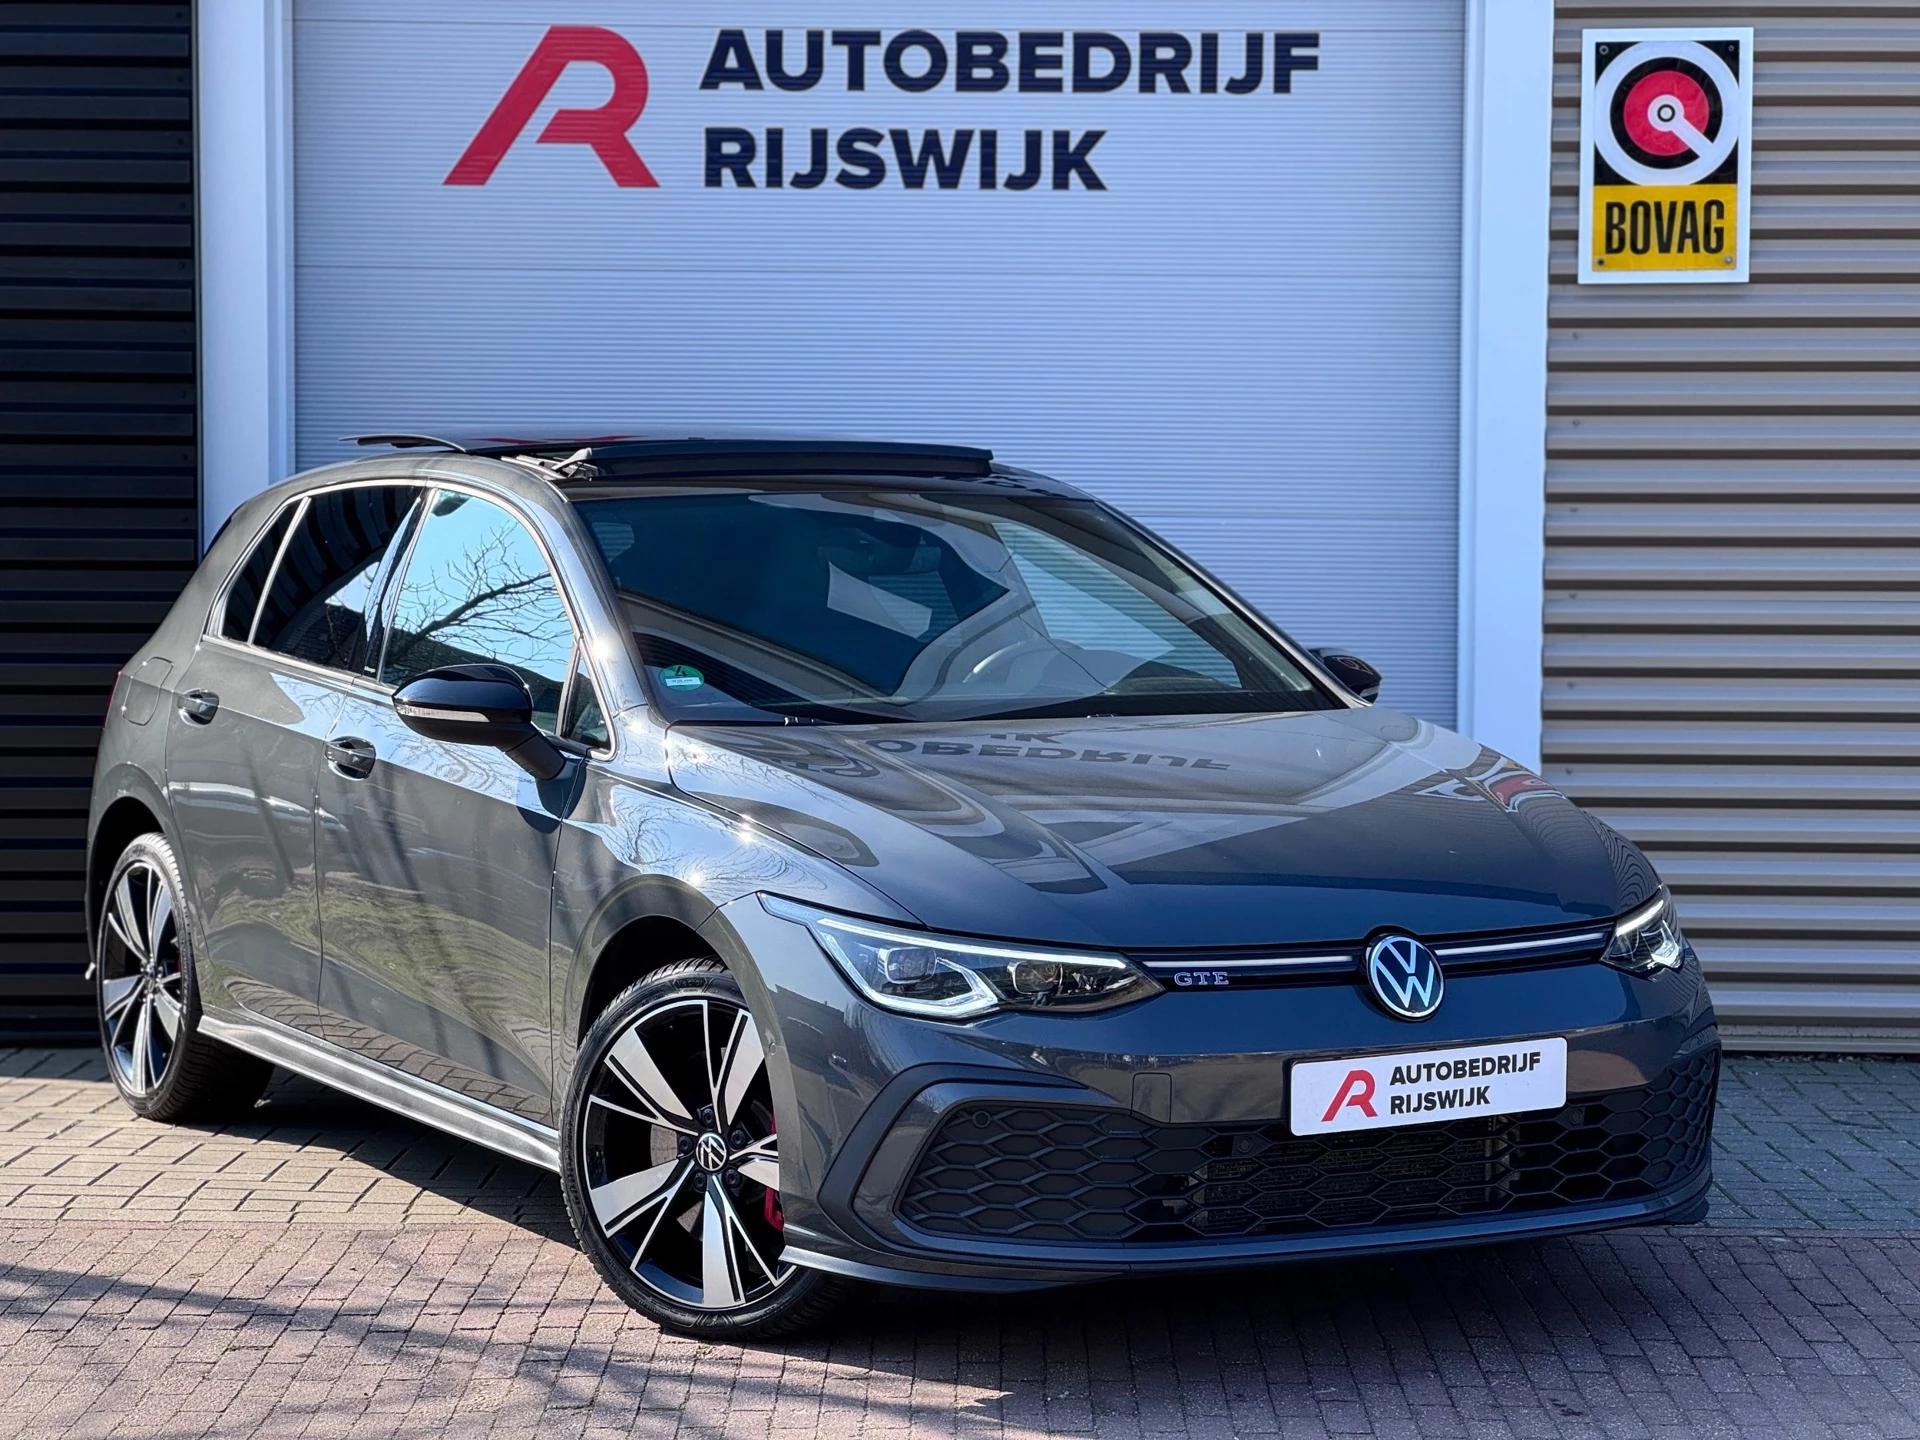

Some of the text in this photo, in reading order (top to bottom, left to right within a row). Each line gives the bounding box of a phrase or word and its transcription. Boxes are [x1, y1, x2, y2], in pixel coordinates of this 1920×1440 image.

[700, 29, 1321, 94] AUTOBEDRIJF
[703, 126, 1108, 191] RIJSWIJK
[1605, 199, 1725, 255] BOVAG
[1174, 971, 1229, 986] GTE
[1390, 1051, 1542, 1086] AUTOBEDRIJF
[1390, 1086, 1491, 1115] RIJSWIJK
